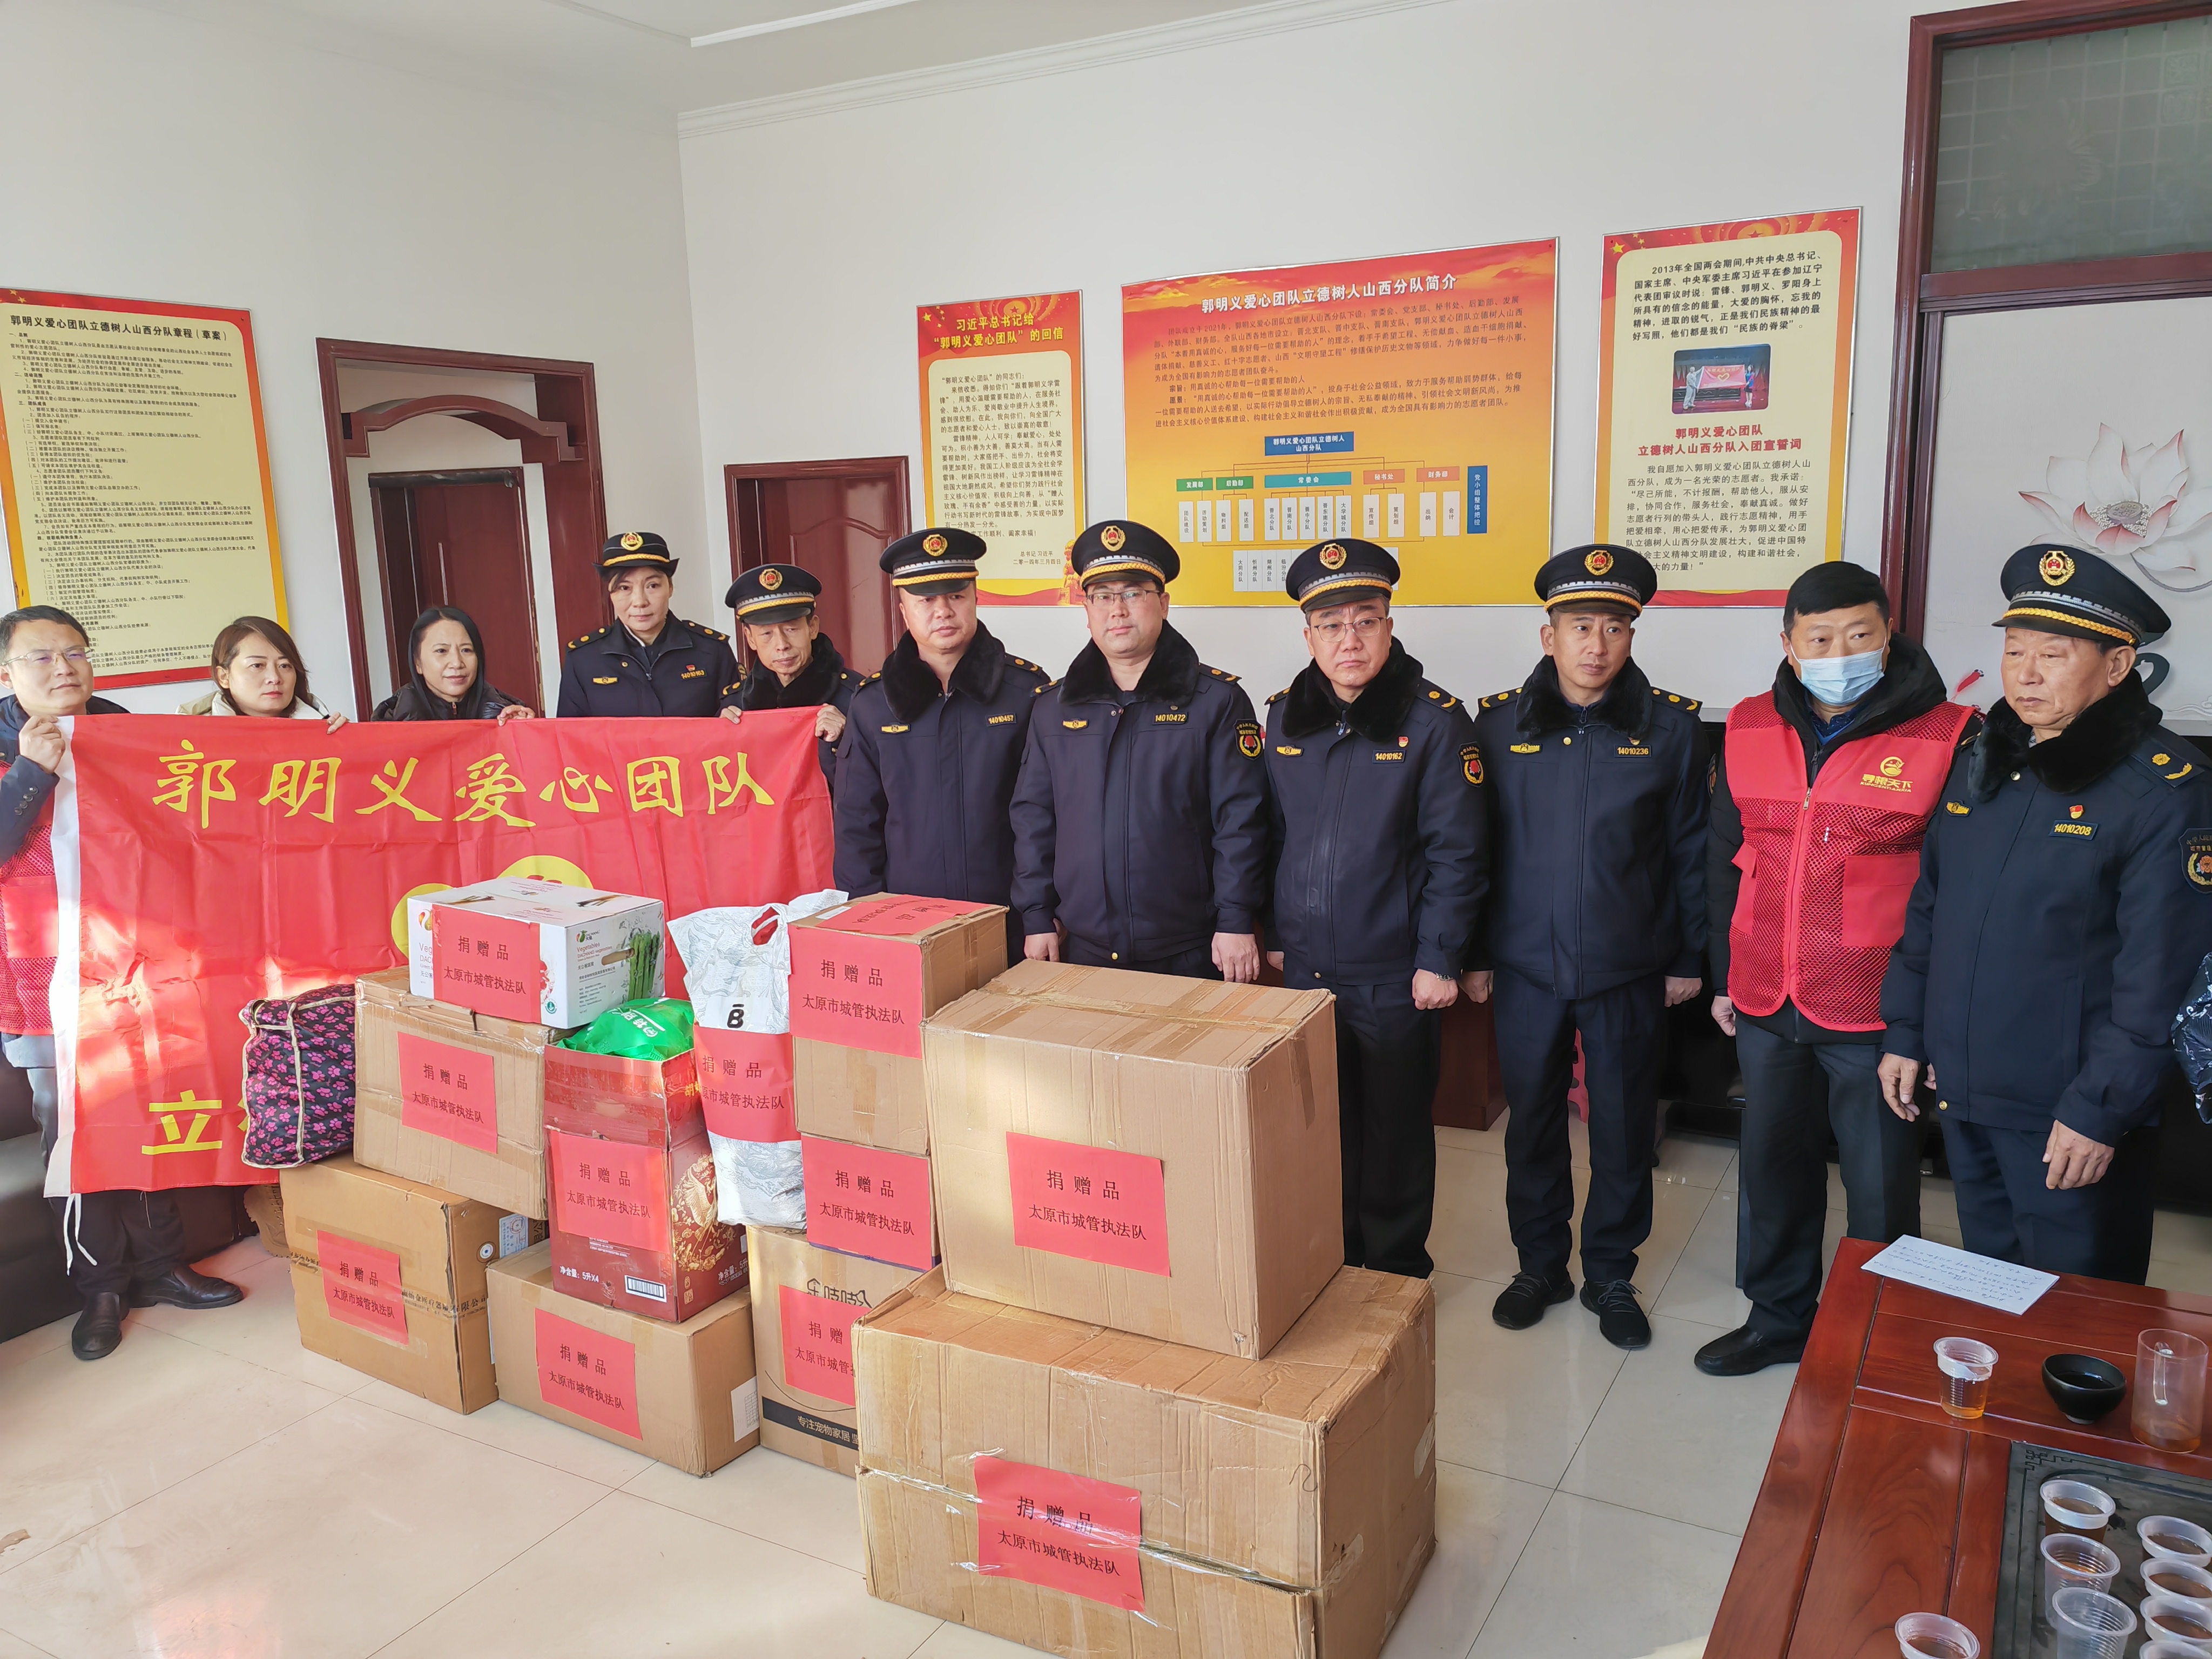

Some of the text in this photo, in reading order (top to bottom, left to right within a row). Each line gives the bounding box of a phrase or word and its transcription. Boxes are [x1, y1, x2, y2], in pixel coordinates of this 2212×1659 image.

[1635, 264, 1823, 289] 国家主席、中央军委主席习近平在参加辽宁
[1201, 273, 1457, 314] 郭明义爱心团队立德树人山西分队简介
[1634, 277, 1822, 302] 代表团审议时说：雷锋、郭明义、罗阳身上
[1633, 304, 1820, 328] 精神，进取的锐气，正是我们民族精神的最
[1634, 291, 1821, 316] 所具有的信念的能量，大爱的胸怀，忘我的
[10, 315, 227, 341] 郭明义爱心团队立德树人山西分队章程（草案）
[956, 312, 1034, 332] 习近平总书记给
[1633, 320, 1803, 341] 好写照，他们都是我们“民族的脊梁”。
[934, 326, 1063, 349] “郭明义爱心团队”的回信
[1273, 434, 1345, 446] 郭明义爱心团队立德树人
[1675, 424, 1763, 439] 郭明义爱心团队
[1296, 443, 1321, 451] 山西分队
[1637, 439, 1802, 456] 立德树人山西分队入团宣誓词
[1647, 459, 1811, 474] 我自愿加入郭明义爱心团队立德树人山
[1298, 476, 1319, 484] 常委会
[1626, 510, 1808, 523] 志愿者行列的带头人，践行志愿精神，用手
[988, 714, 1014, 725] 14010457
[1155, 714, 1186, 722] 14010472
[1617, 747, 1649, 755] 14010236
[152, 739, 775, 829] 郭明义爱心团队
[1862, 774, 1913, 788] 寻根天下
[2054, 824, 2092, 836] 14010208
[458, 935, 509, 961] 捐赠品
[443, 965, 527, 995] 太原市城管执法队
[821, 959, 883, 987] 捐赠品
[802, 993, 906, 1025] 太原市城管执法队
[423, 1063, 468, 1090] 捐赠品
[703, 1054, 761, 1078] 捐赠品
[412, 1091, 484, 1124] 太原市城管执法队
[702, 1085, 785, 1110] 原市城管执法队
[579, 1162, 631, 1187] 捐赠品
[835, 1170, 894, 1198] 捐赠品
[1047, 1169, 1120, 1201] 捐赠品
[567, 1190, 651, 1219] 太原市城管执法队
[819, 1202, 915, 1236] 太原市城管执法队
[1028, 1204, 1147, 1240] 太原市城管执法队
[339, 1260, 379, 1289] 捐赠品
[333, 1286, 395, 1320] 太原市城管执法队
[808, 1320, 844, 1345] 捐赠
[560, 1343, 607, 1376] 捐赠品
[549, 1370, 625, 1411] 太原市城管执法队
[798, 1415, 851, 1442] 专注宠物家居
[1017, 1495, 1094, 1535] 捐赠品
[997, 1530, 1121, 1577] 太原市城管执法队
